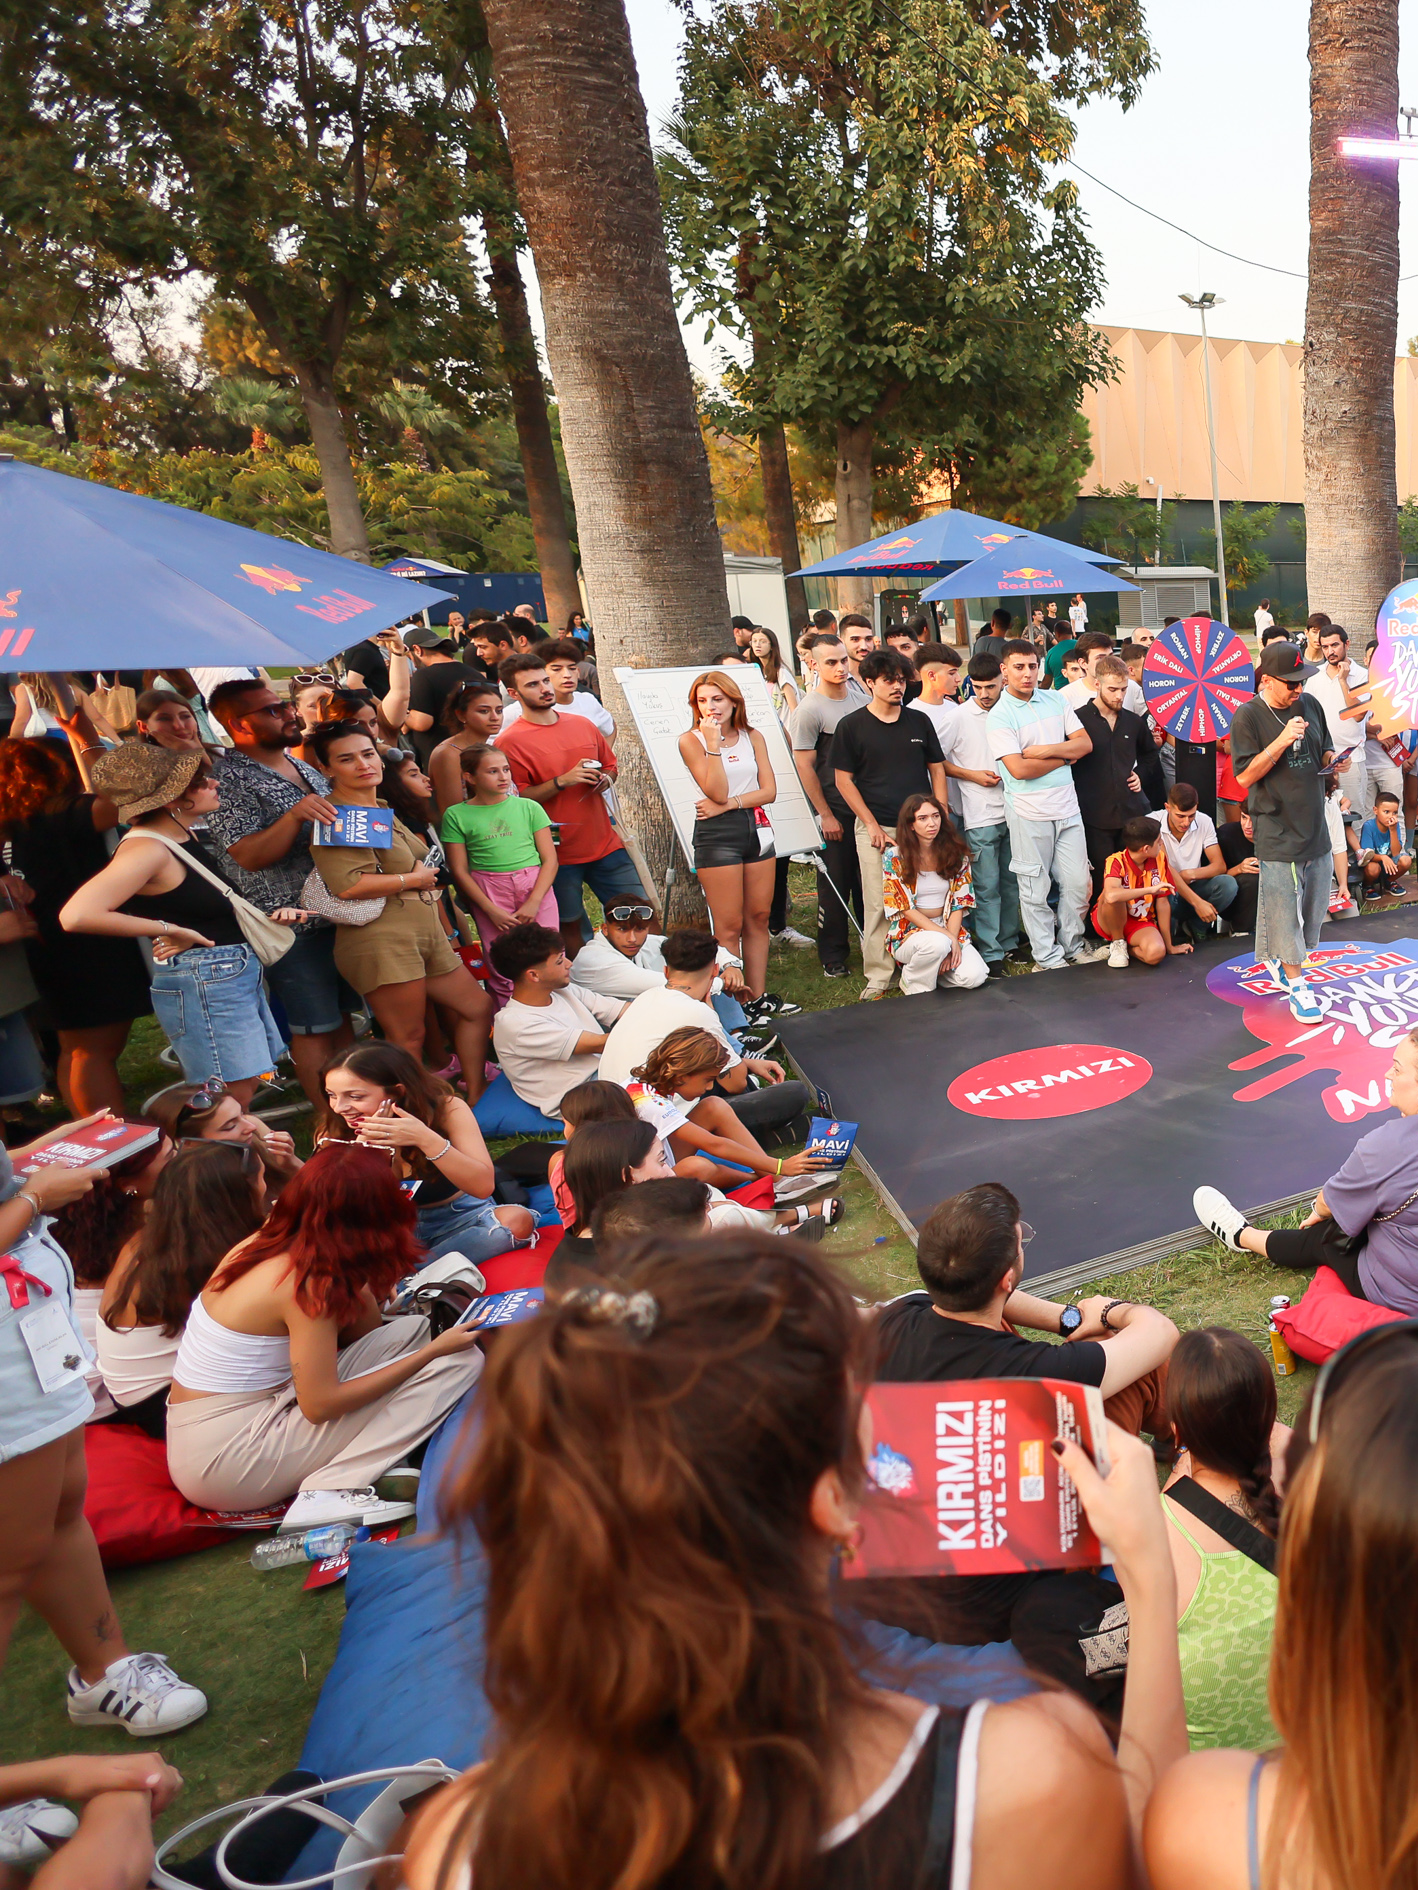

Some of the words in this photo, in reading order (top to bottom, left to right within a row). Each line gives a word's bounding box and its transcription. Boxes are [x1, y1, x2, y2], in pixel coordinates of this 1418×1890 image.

[997, 581, 1030, 590] Red
[1032, 580, 1064, 589] Bull
[1170, 632, 1189, 660] ROMAN
[1194, 625, 1202, 654] HİPHOP
[1209, 631, 1224, 657] ZEYBEK
[1153, 653, 1168, 665] ERİK
[1169, 661, 1184, 674] DALI
[1212, 650, 1242, 674] ORYANTAL
[1148, 680, 1175, 688] HORON
[1224, 675, 1249, 683] HORON
[1156, 689, 1188, 714] ORYANTAL
[1216, 689, 1230, 701] DALI
[1175, 705, 1191, 732] ZEYBEK
[1198, 709, 1206, 737] HİPHOP
[1211, 703, 1229, 729] ROMAN
[355, 810, 370, 843] MAVİ
[1242, 968, 1340, 994] Rd
[1327, 952, 1415, 978] Bull
[963, 1056, 1136, 1105] KIRMIZI
[45, 1142, 107, 1160] KIRMIZI
[811, 1138, 850, 1150] MAVİ
[496, 1291, 529, 1323] MAVİ
[975, 1400, 993, 1486] PİSTİNİN
[936, 1401, 977, 1550] KIRMIZI
[994, 1399, 1008, 1547] YILDIZI
[979, 1490, 995, 1549] DANS
